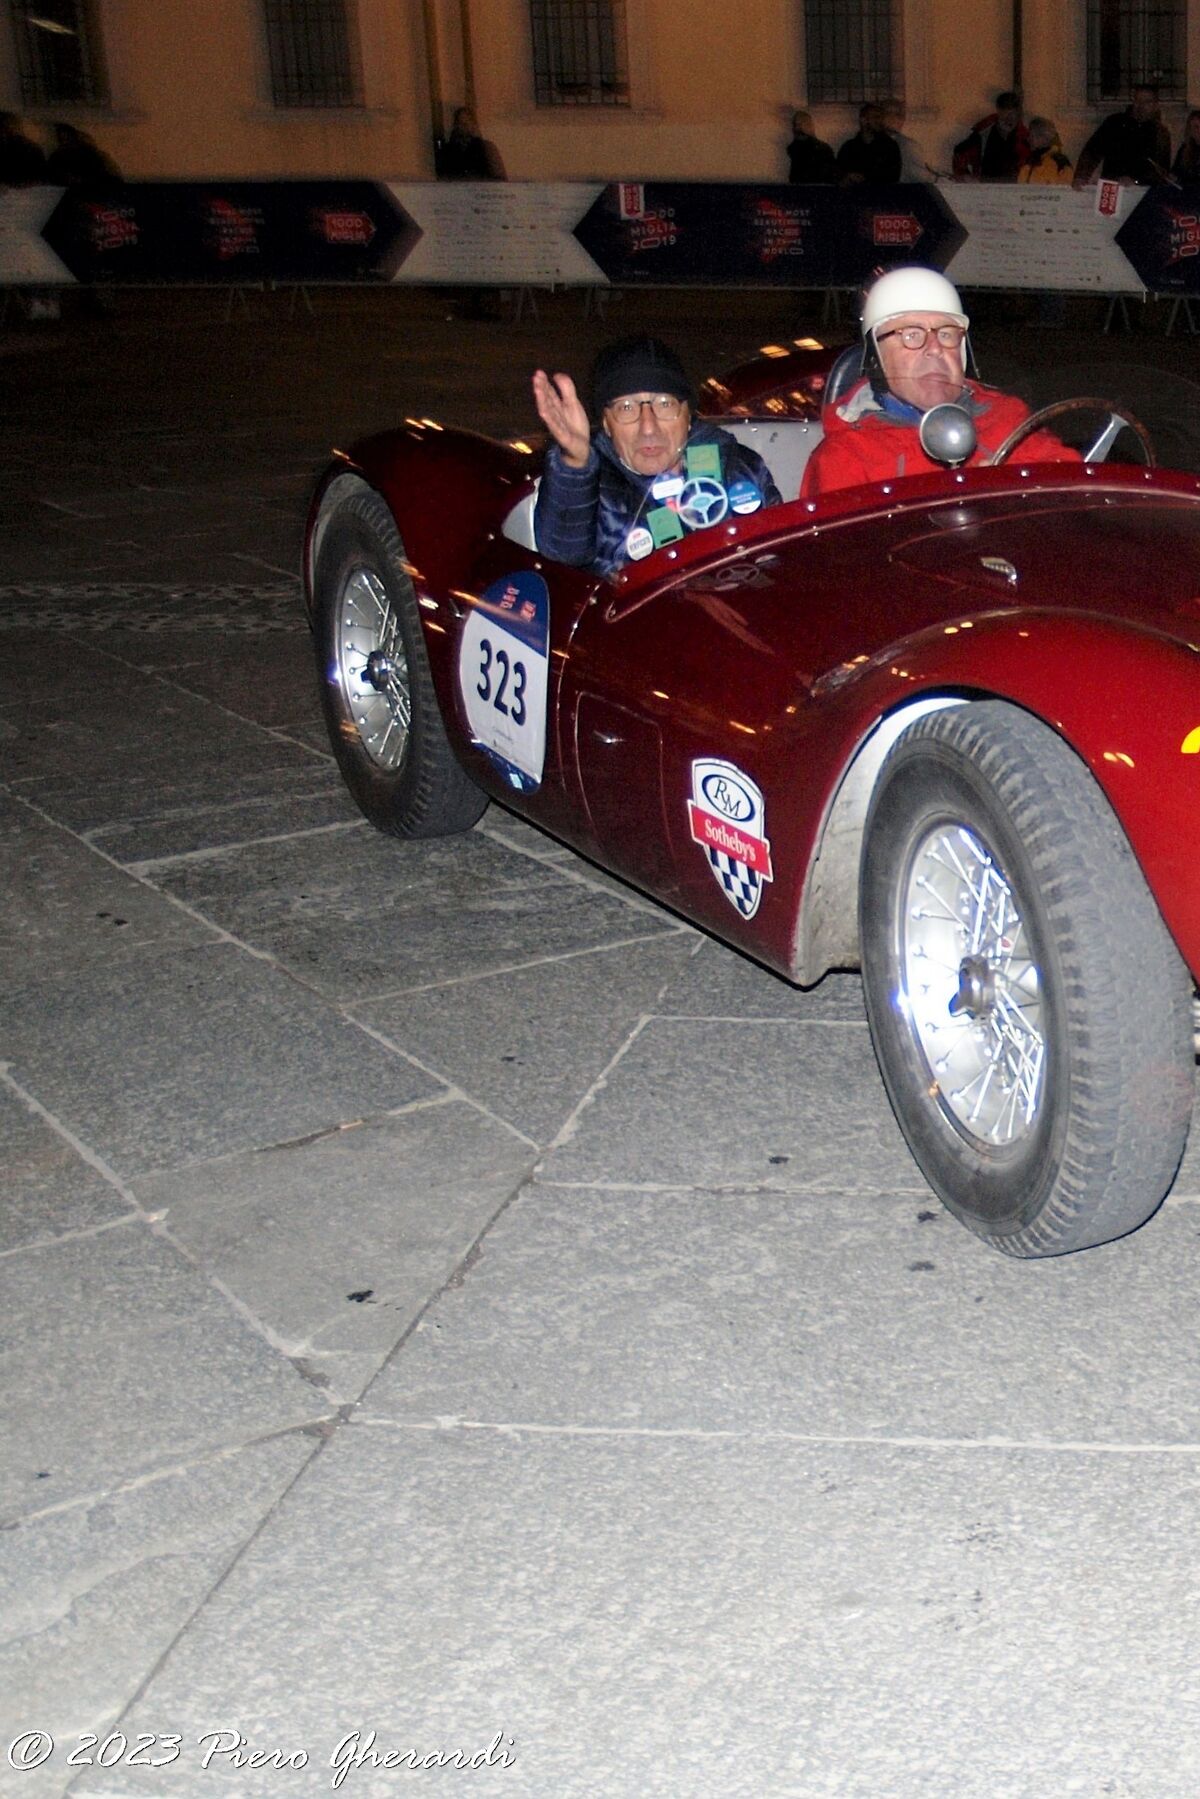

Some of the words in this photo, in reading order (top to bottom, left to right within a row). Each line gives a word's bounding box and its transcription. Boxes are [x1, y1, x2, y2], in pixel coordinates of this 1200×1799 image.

[331, 217, 363, 229] 1000
[879, 219, 911, 231] 1000
[633, 235, 677, 251] 2019
[476, 638, 527, 727] 323
[713, 779, 742, 818] RM
[704, 818, 757, 862] Sotheby's
